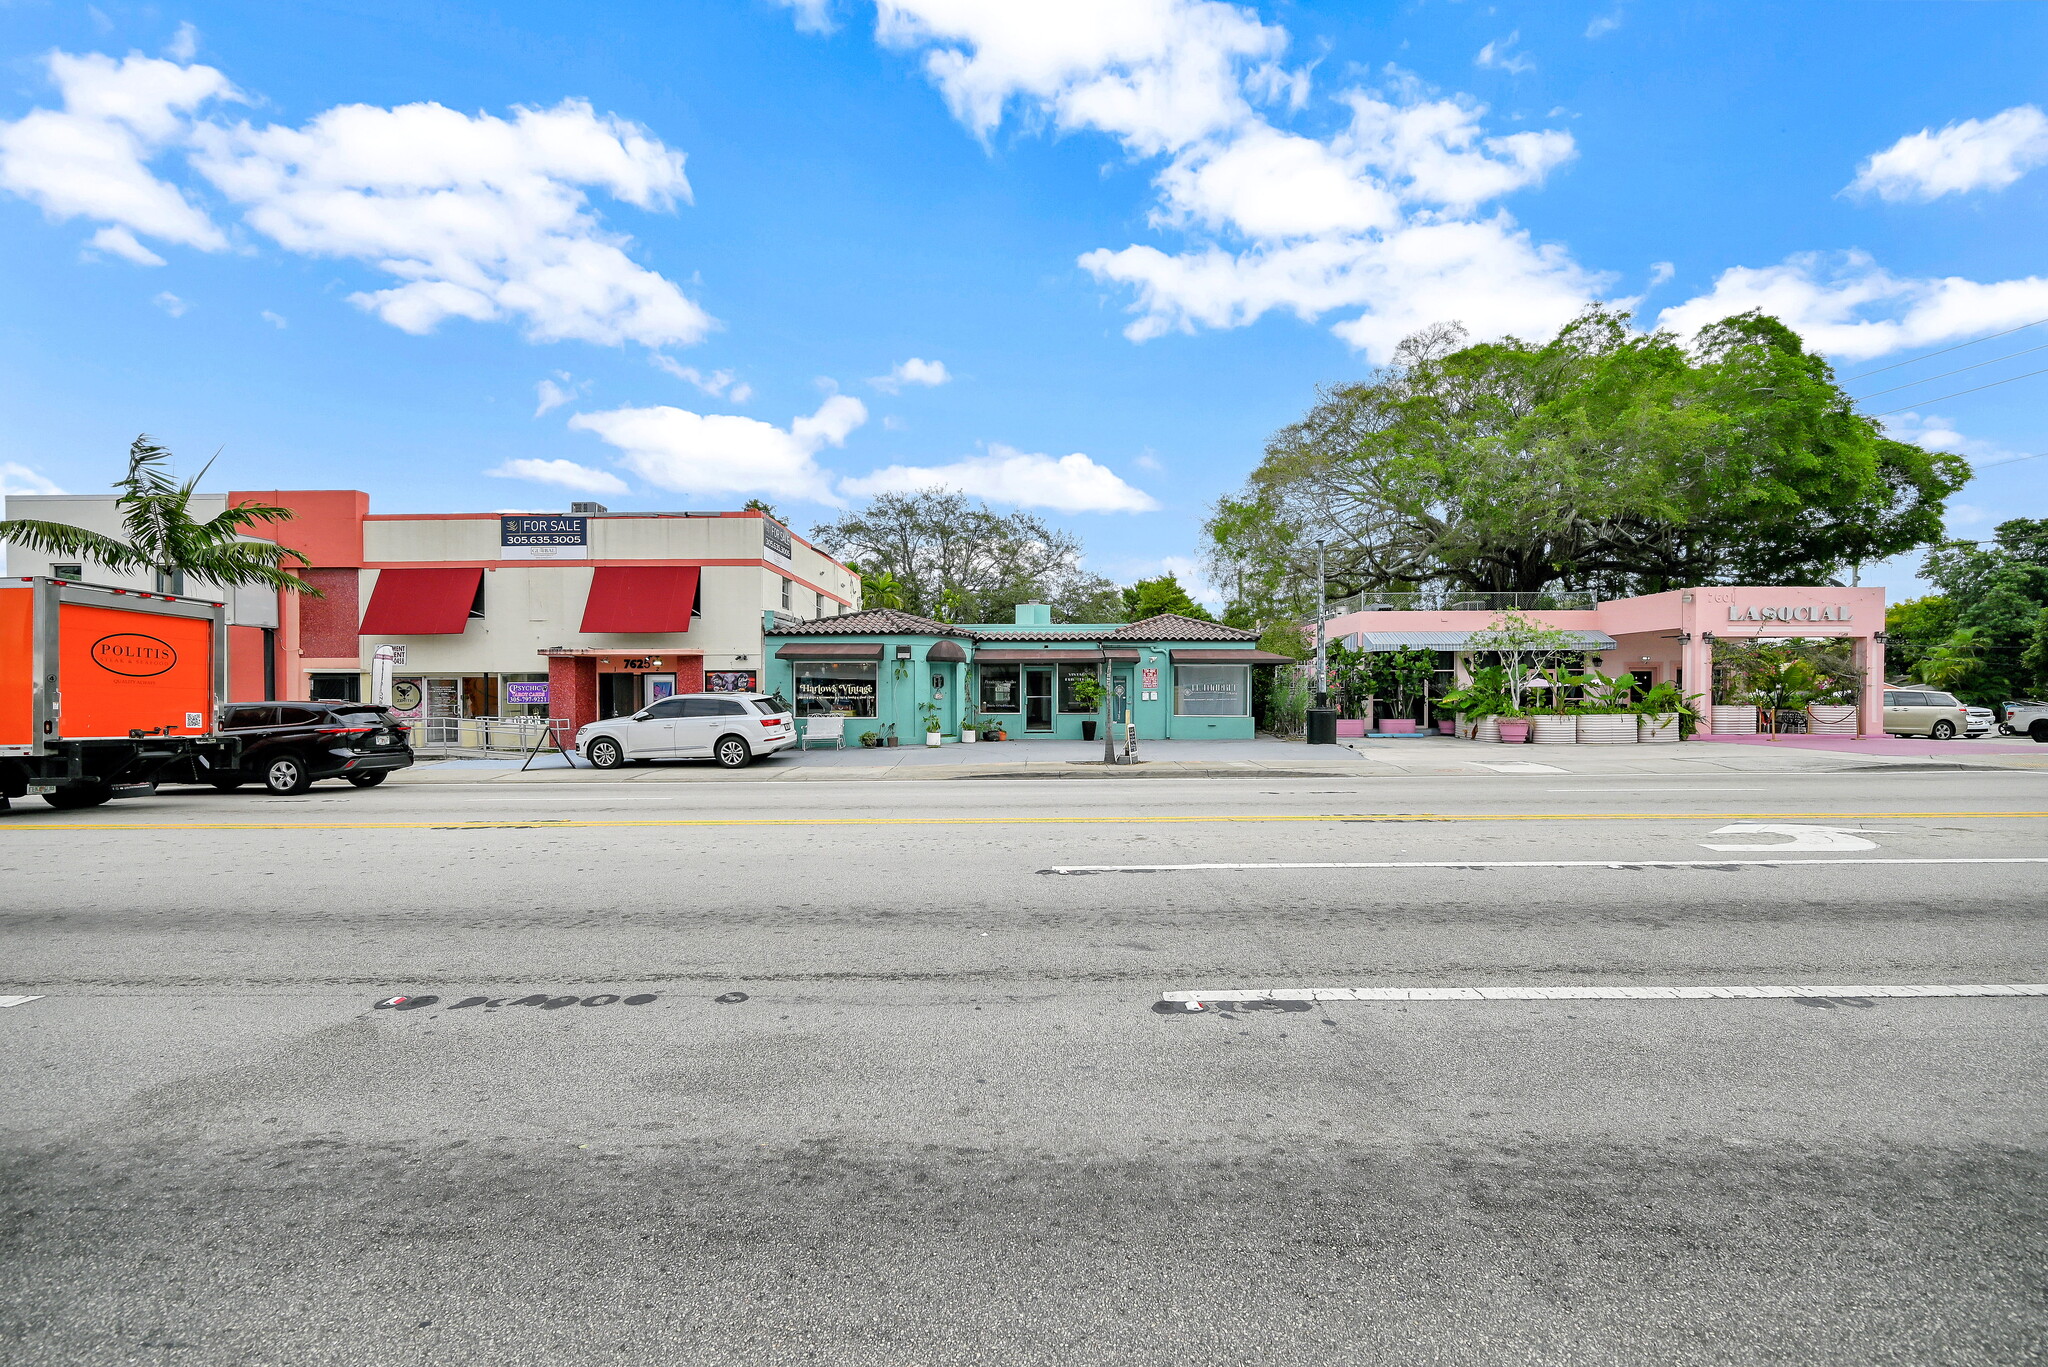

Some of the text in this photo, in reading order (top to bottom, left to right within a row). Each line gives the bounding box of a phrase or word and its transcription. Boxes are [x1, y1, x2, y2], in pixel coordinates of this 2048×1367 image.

[523, 520, 581, 531] FOR SALE
[771, 525, 780, 540] FOR
[506, 534, 581, 544] 305.635.3005
[101, 644, 170, 660] POLITIS
[623, 658, 651, 669] 7625
[838, 684, 873, 695] Vintage
[512, 715, 541, 725] OPEN
